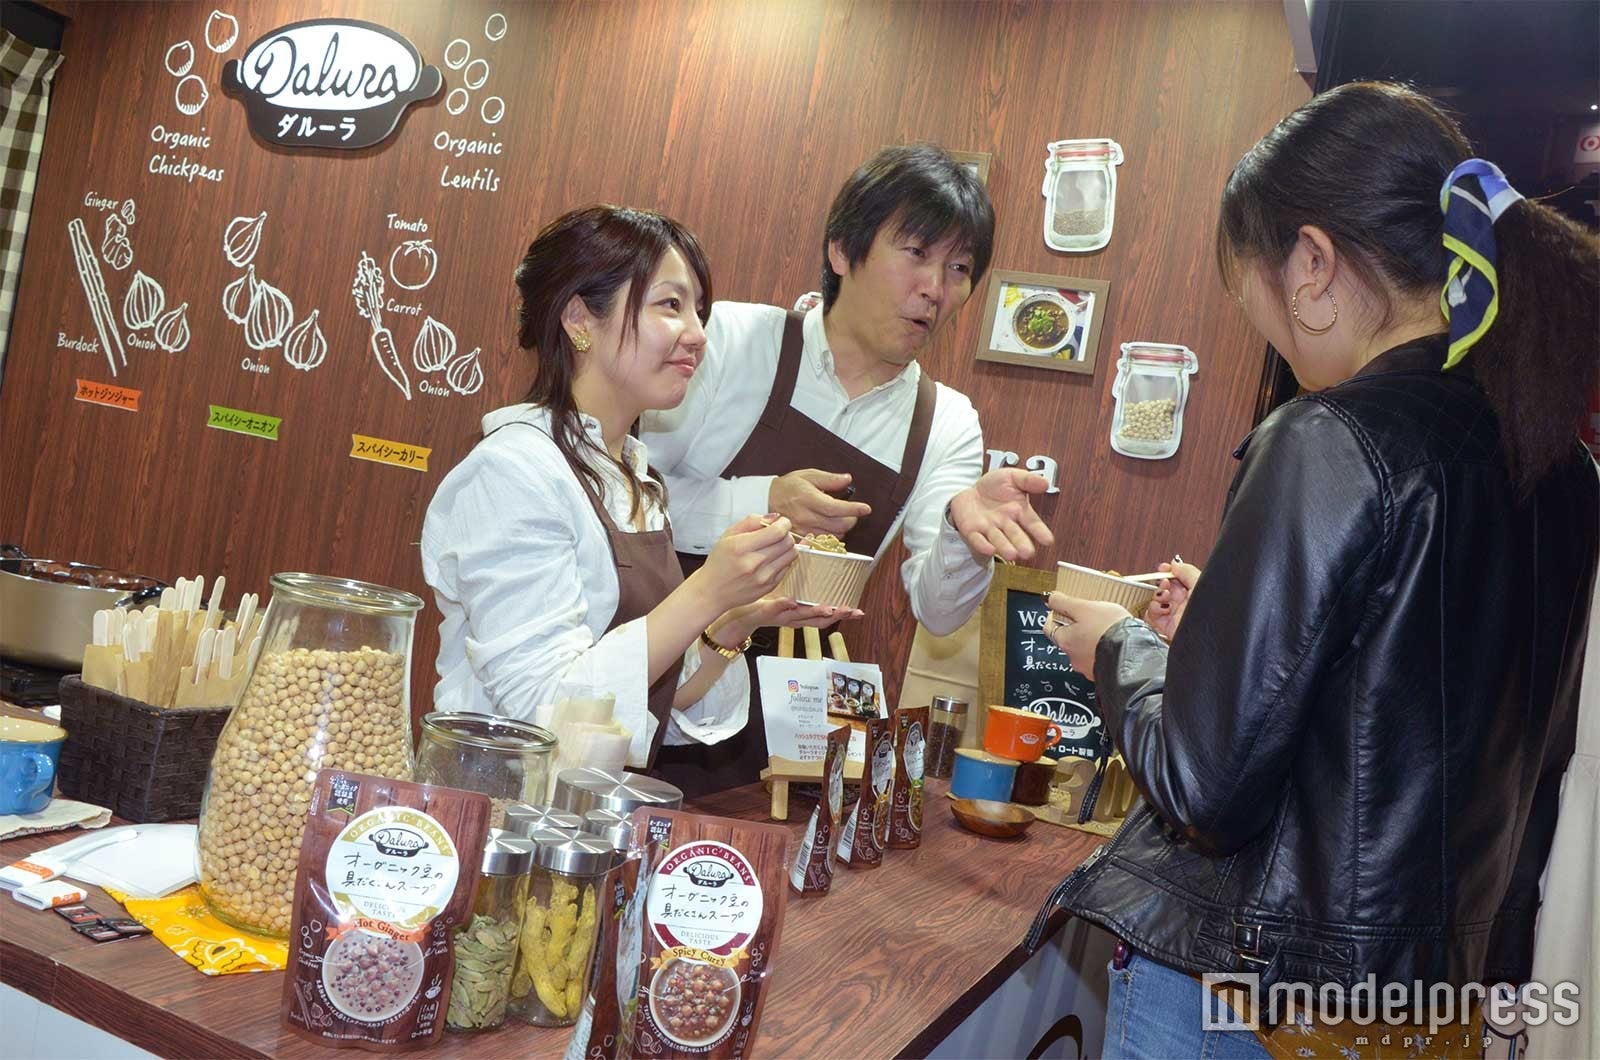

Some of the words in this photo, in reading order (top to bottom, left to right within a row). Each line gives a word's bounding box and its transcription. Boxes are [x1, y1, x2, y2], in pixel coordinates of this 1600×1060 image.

[254, 32, 400, 99] Dalura
[151, 125, 211, 149] Organic
[277, 113, 357, 141] ダルーラ
[434, 131, 502, 157] Organic
[149, 155, 224, 182] Chickpeas
[440, 166, 501, 192] Lentils
[84, 191, 119, 211] Ginger
[387, 213, 428, 233] Tomato
[386, 298, 422, 316] Carrot
[57, 332, 99, 353] Burdock
[127, 333, 156, 351] Onion
[241, 357, 270, 374] Onion
[79, 386, 136, 405] ホットジンジャー
[419, 379, 450, 397] Onion
[212, 411, 276, 433] スパイシーオニオン
[356, 441, 425, 465] スパイシーカリー
[1033, 701, 1090, 726] Dalura
[376, 831, 420, 849] Dalura
[666, 847, 719, 872] ORGANIC
[723, 852, 752, 883] BEANS
[692, 864, 727, 880] Dalura
[661, 883, 749, 908] オーガニック豆の
[660, 902, 745, 923] 具だくさんスープ
[377, 921, 409, 940] Ginger
[672, 948, 697, 958] Spicy
[700, 951, 726, 967] Curry
